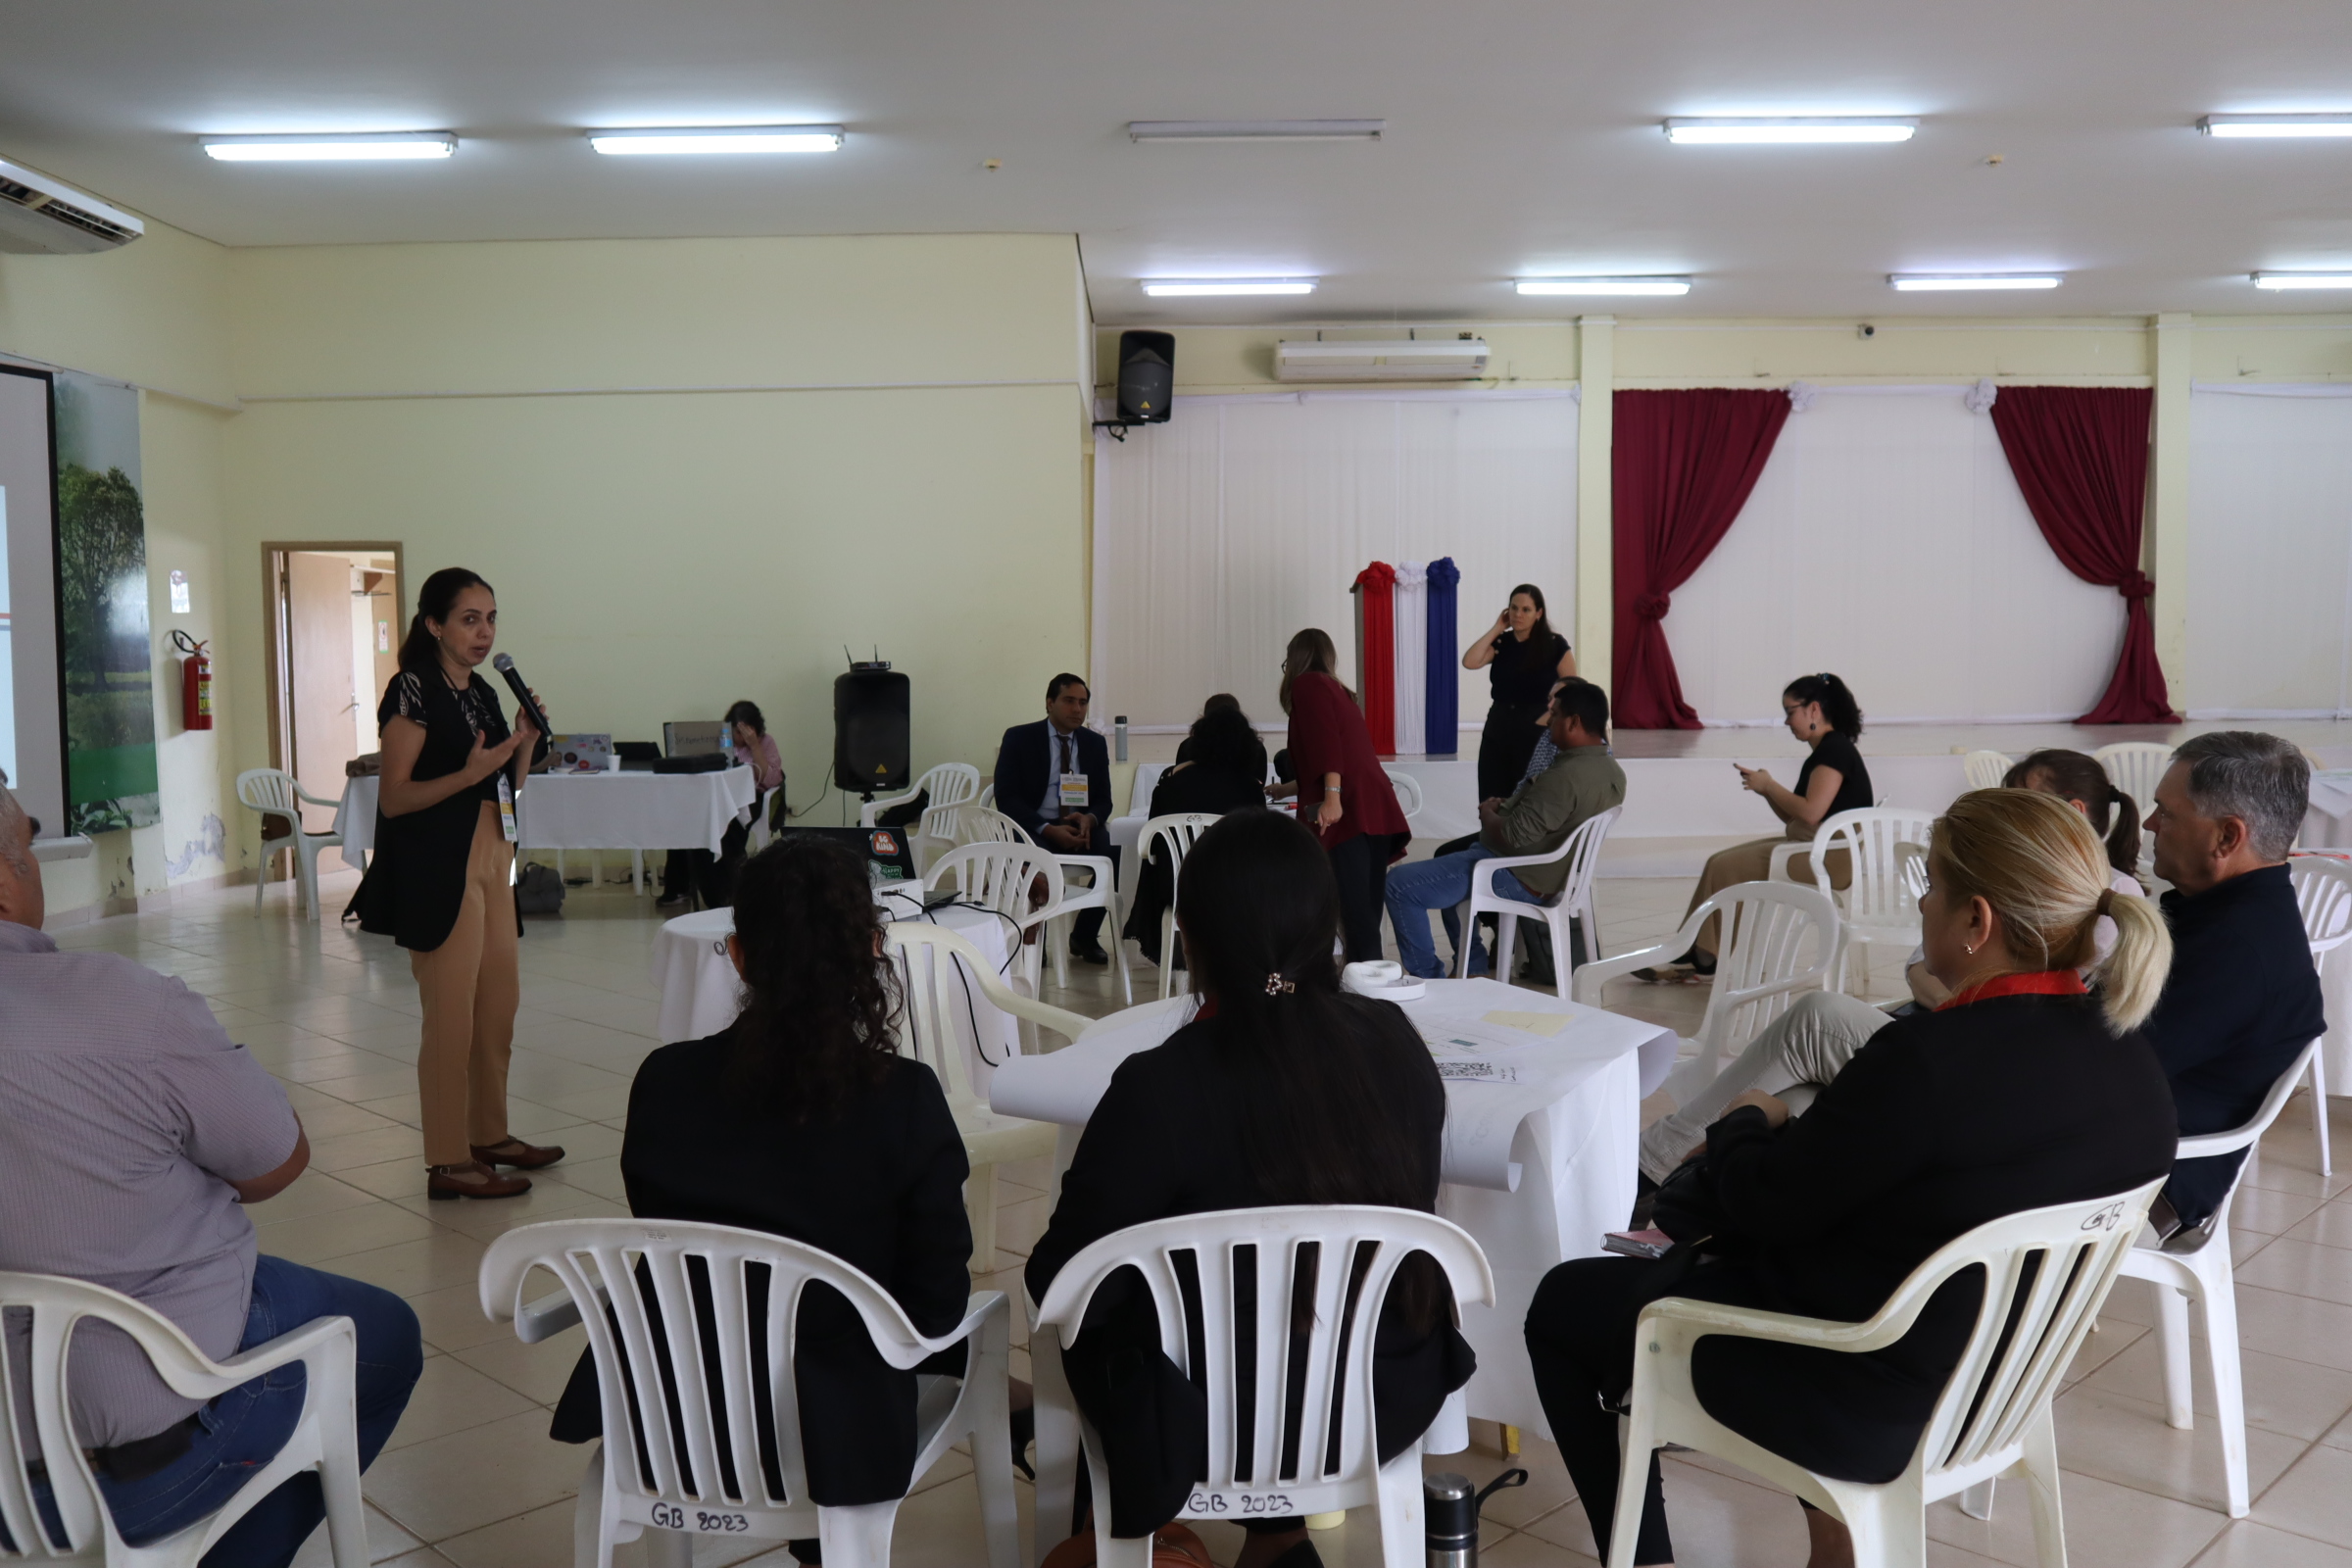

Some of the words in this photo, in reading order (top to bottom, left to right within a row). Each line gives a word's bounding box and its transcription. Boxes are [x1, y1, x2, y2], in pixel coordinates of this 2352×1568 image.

[652, 1502, 684, 1529] GB
[697, 1511, 749, 1532] 2023
[1188, 1493, 1229, 1513] GB
[1241, 1494, 1294, 1515] 2023
